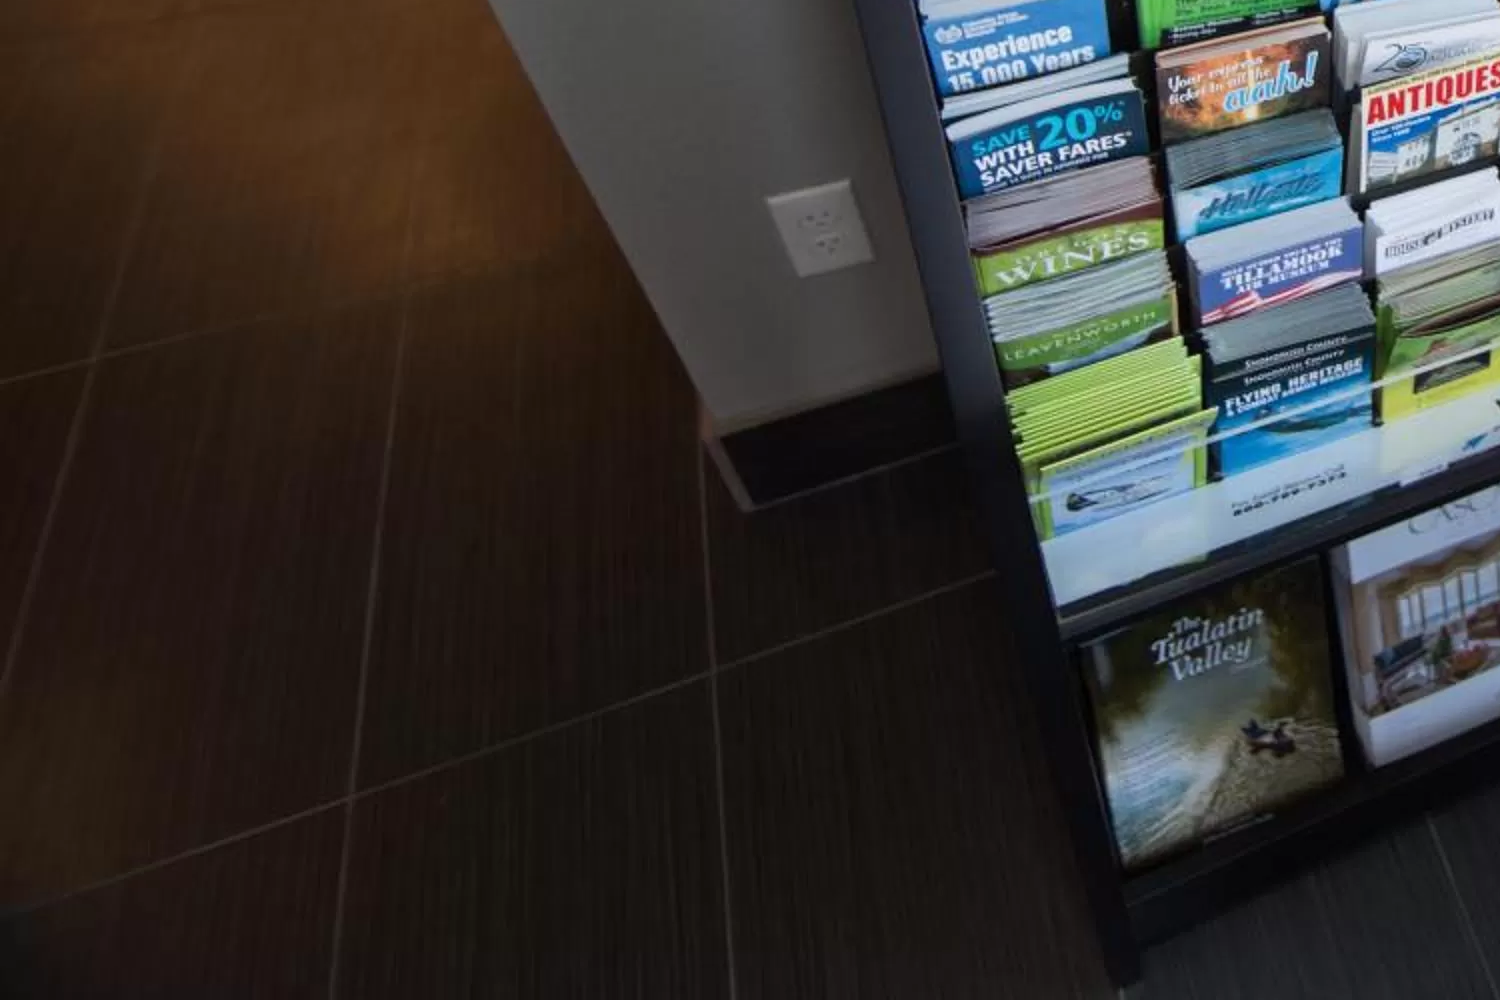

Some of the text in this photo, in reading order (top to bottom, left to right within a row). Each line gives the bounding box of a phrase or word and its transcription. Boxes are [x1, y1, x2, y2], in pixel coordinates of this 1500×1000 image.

[940, 25, 1073, 71] Experience
[1030, 44, 1096, 74] Years
[971, 124, 1032, 157] SAVE
[973, 140, 1035, 172] WITH
[979, 152, 1053, 187] SAVER
[995, 230, 1150, 286] WINES
[1220, 243, 1344, 290] TILLAMOOK
[1235, 260, 1330, 295] AIR MUSEUM
[1004, 310, 1157, 362] LEAVENWORTH
[1225, 356, 1364, 411] FLYING HERITAGE
[1151, 607, 1265, 665] Tualatin
[1171, 615, 1201, 634] The
[1169, 637, 1252, 682] Valley
